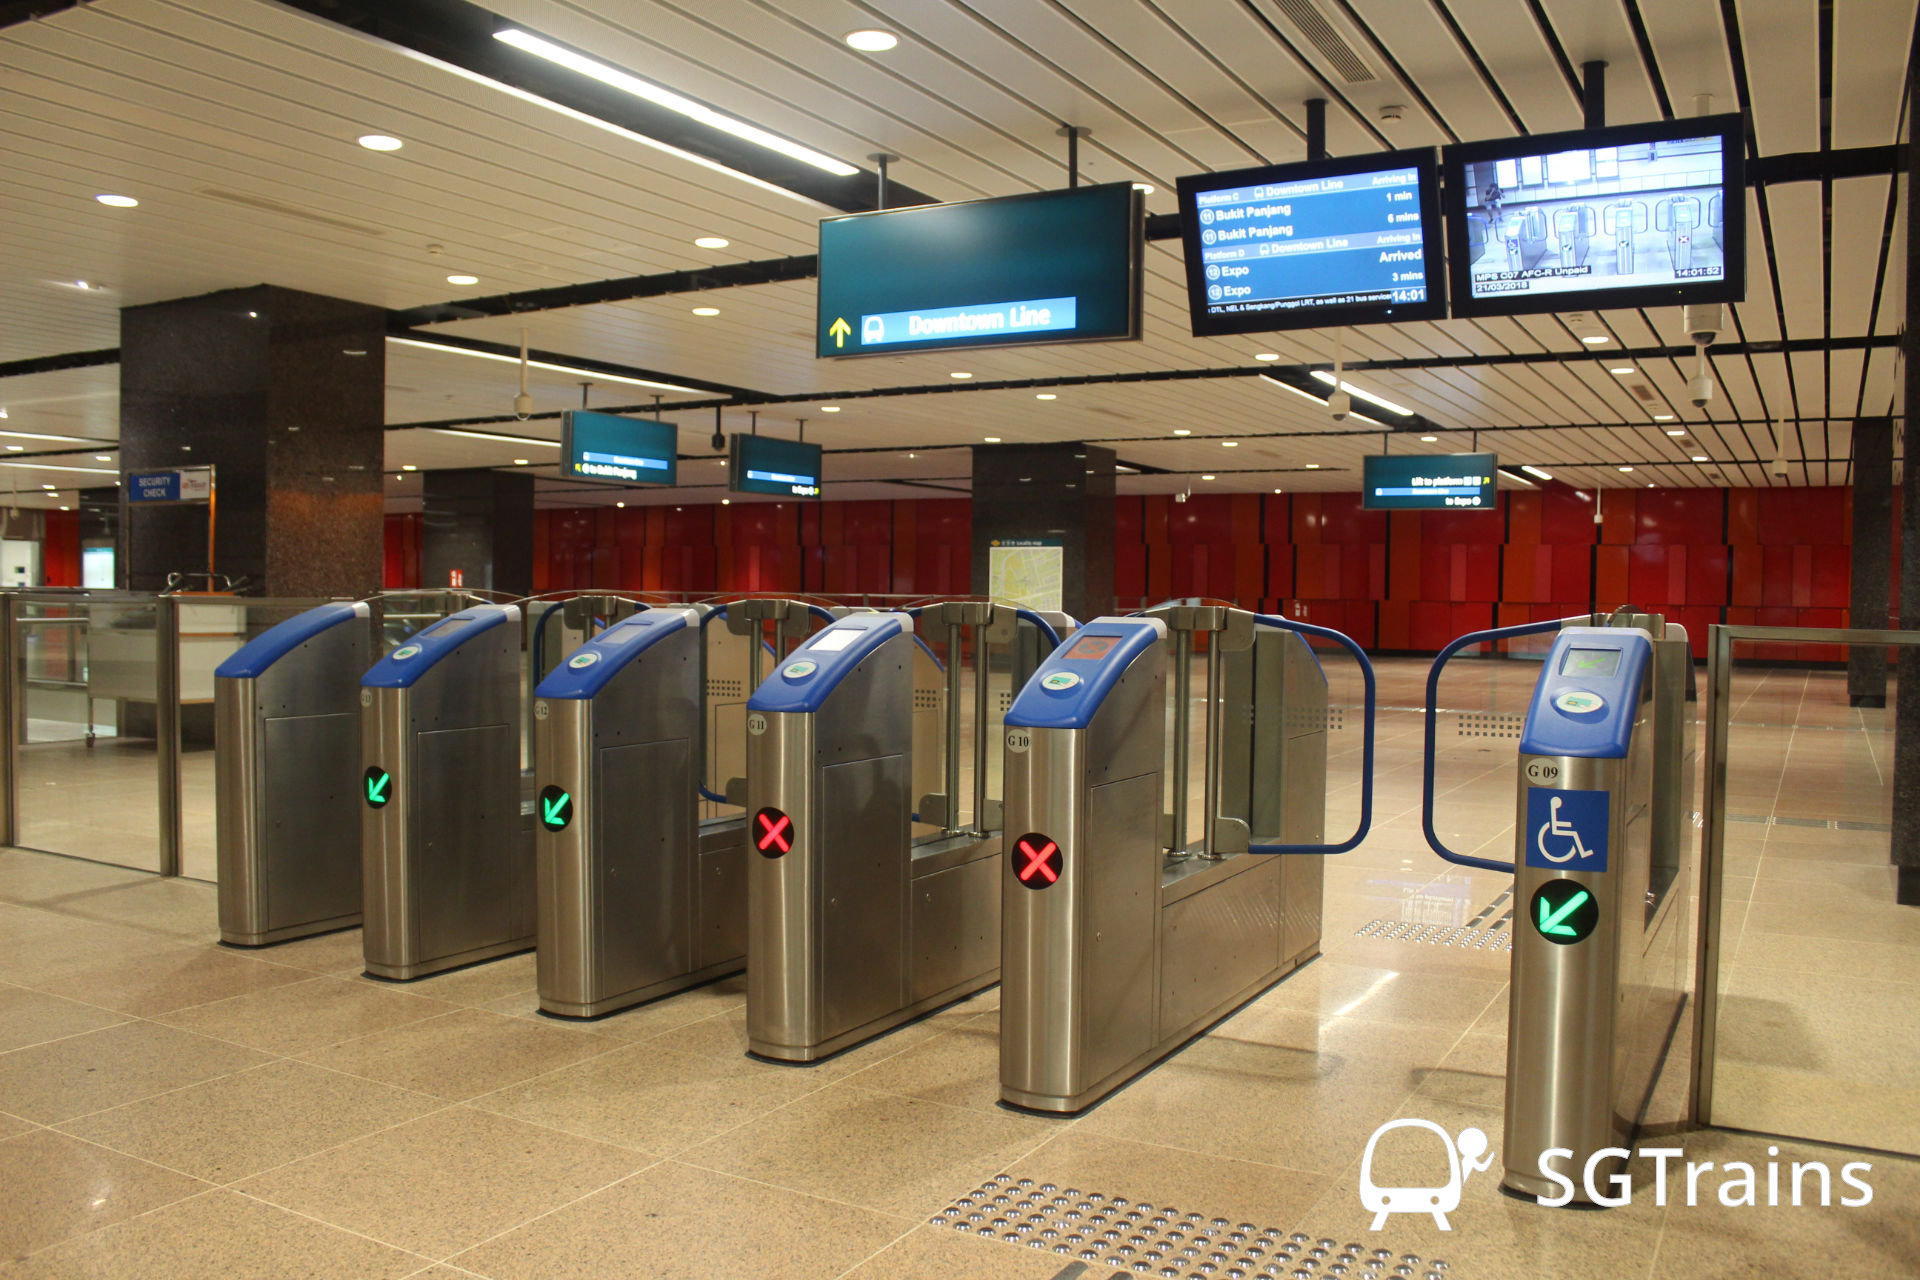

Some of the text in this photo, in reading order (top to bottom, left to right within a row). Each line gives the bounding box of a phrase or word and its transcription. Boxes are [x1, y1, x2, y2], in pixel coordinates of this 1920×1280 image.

[1372, 172, 1417, 185] Arriving In
[1266, 179, 1344, 197] Downtown Line
[1386, 190, 1413, 202] 1 min
[1215, 207, 1245, 221] Bukit
[1246, 204, 1292, 218] Panjang
[1387, 211, 1420, 223] 6 mins
[1217, 227, 1247, 241] Bukit
[1248, 224, 1294, 239] Panjang
[1376, 231, 1421, 245] Arriving In
[1271, 237, 1349, 254] Downtown Line
[1379, 248, 1422, 263] Arrived
[1221, 265, 1250, 278] Expo
[1392, 271, 1424, 282] 3 mins
[1476, 265, 1588, 282] MPS C07 AFC-R Unpaid
[1676, 266, 1720, 278] 14:01:52
[1223, 285, 1252, 298] Expo
[1476, 281, 1528, 292] 21/03/2018
[1392, 289, 1424, 303] 14:01
[908, 305, 1051, 336] Downtown Line
[138, 476, 171, 487] SECURITY
[143, 488, 166, 498] CHECK
[1007, 735, 1029, 747] G 10
[1527, 764, 1559, 779] G 09
